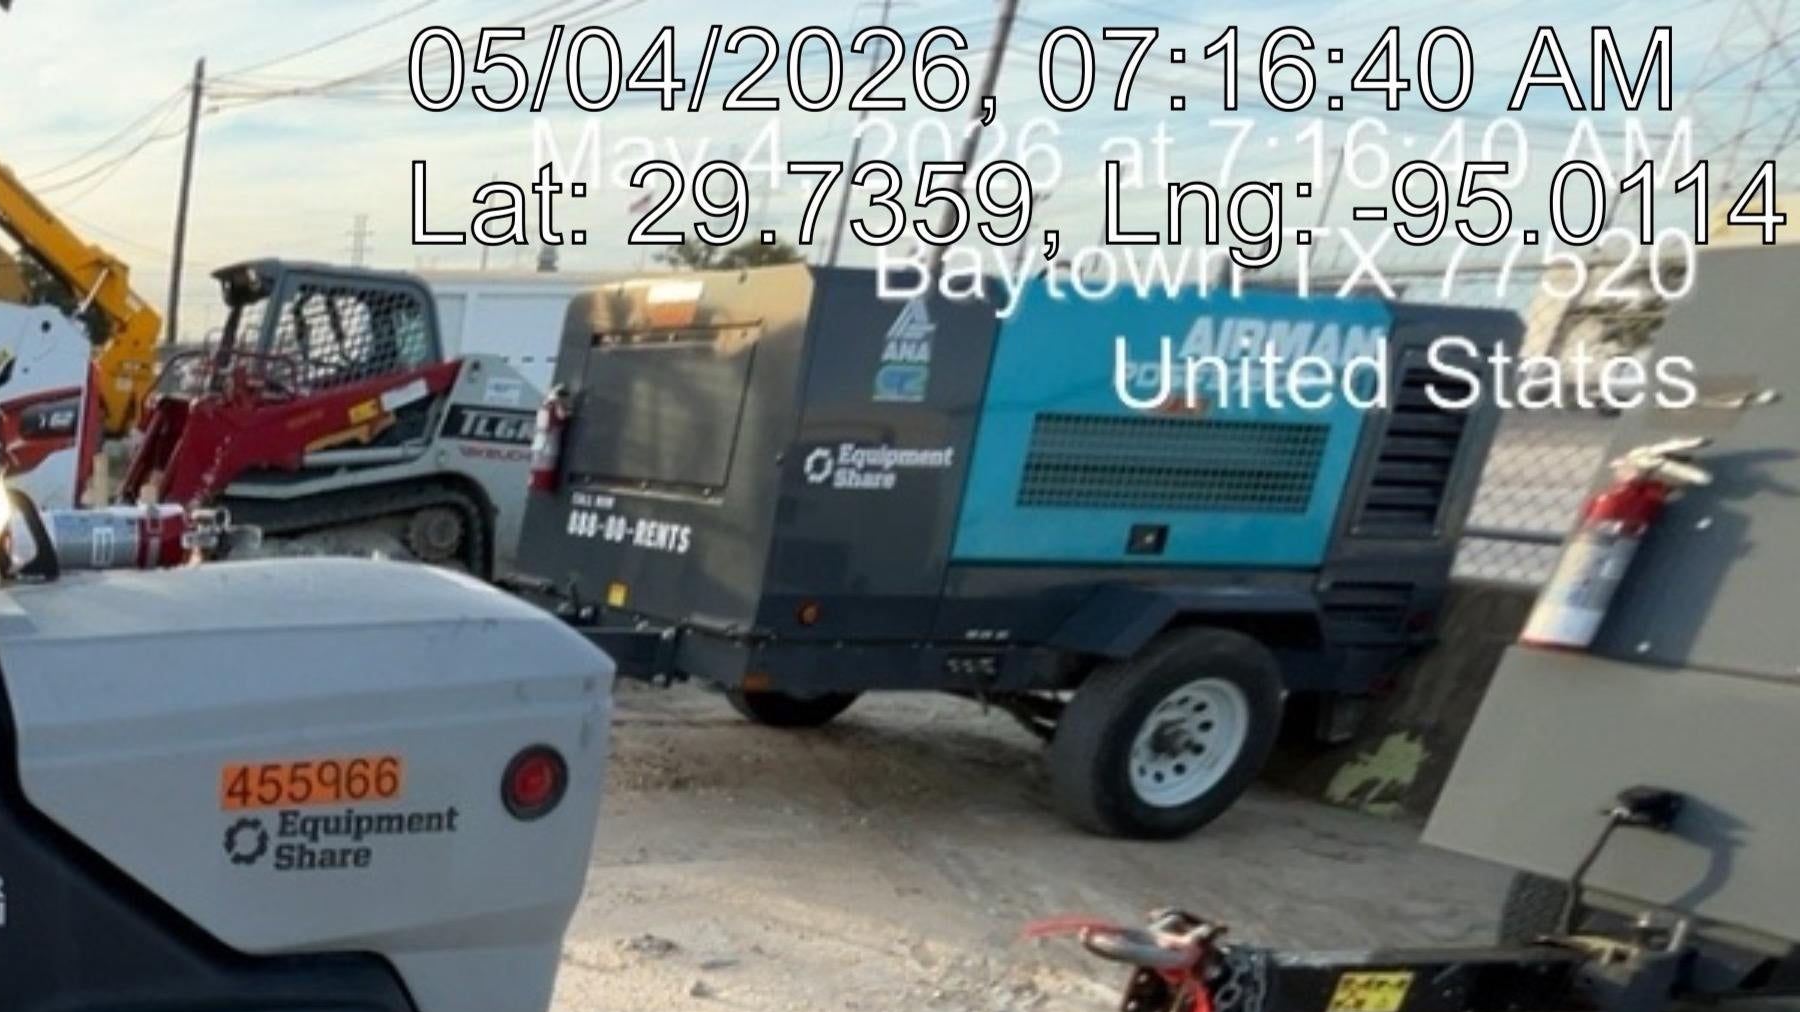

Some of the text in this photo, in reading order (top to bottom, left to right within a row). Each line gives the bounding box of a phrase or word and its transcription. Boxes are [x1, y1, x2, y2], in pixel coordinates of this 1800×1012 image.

[837, 443, 954, 469] Equipment
[832, 467, 896, 489] Share
[226, 756, 399, 807] 455966
[277, 805, 459, 842] Equipment
[274, 844, 372, 870] Share
